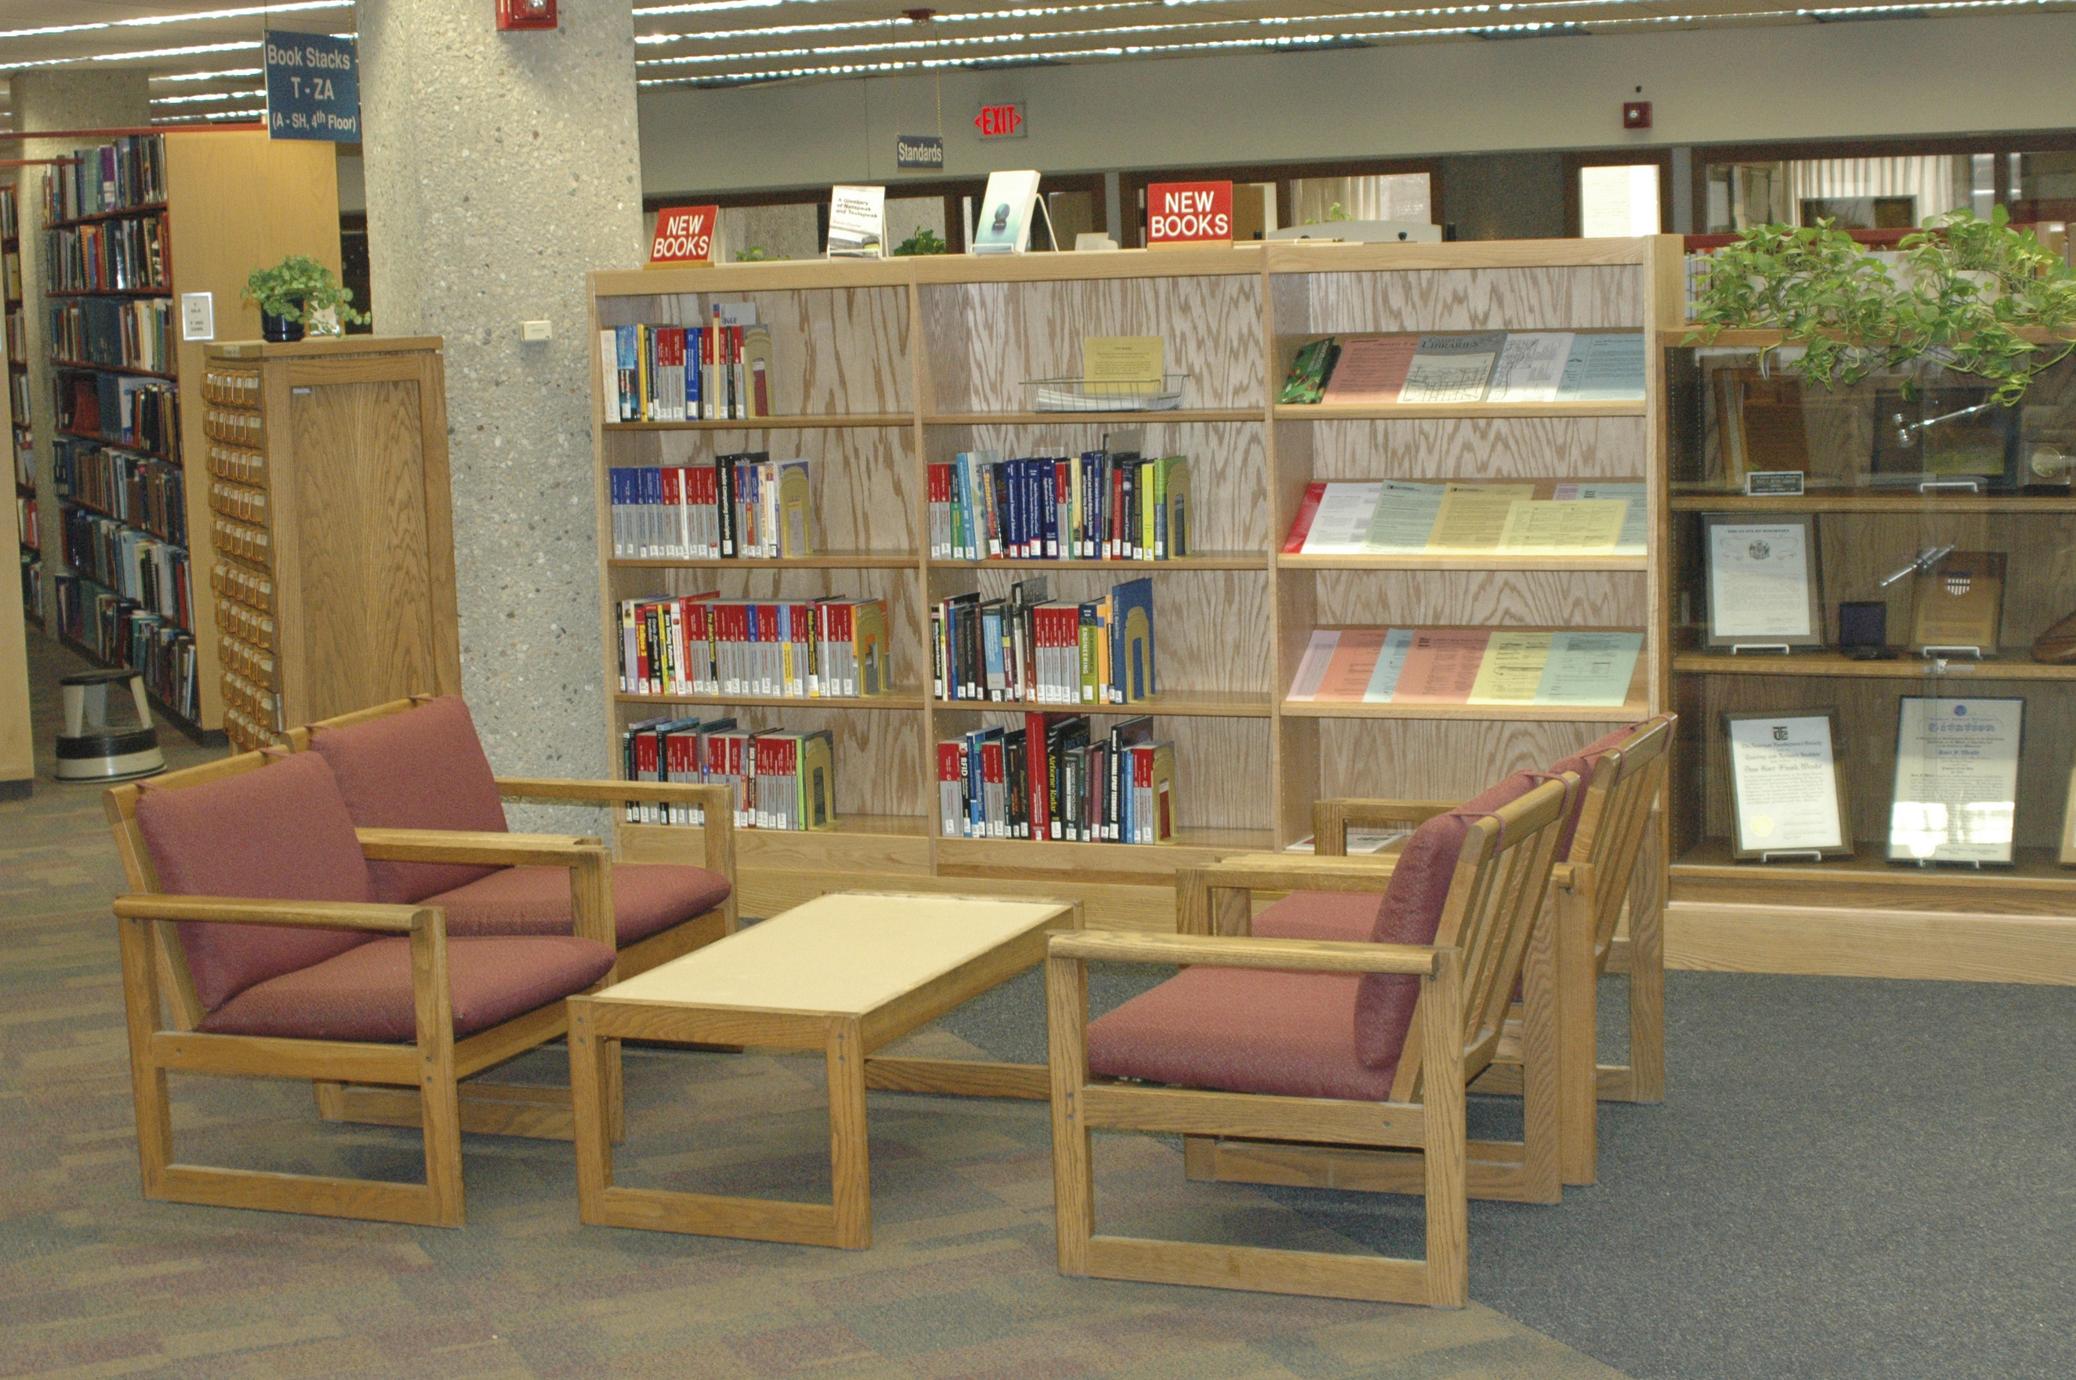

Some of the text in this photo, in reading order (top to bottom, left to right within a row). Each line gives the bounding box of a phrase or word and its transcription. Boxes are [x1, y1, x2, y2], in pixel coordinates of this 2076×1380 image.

[267, 44, 351, 71] Book Stacks
[290, 77, 301, 99] T
[313, 78, 335, 100] ZA
[272, 112, 284, 131] (A
[291, 113, 310, 131] SH,
[328, 114, 356, 134] Floor)
[981, 104, 1016, 136] EXIT
[898, 141, 942, 163] Standards
[1165, 190, 1215, 214] NEW
[666, 214, 705, 236] NEW
[1151, 213, 1229, 238] BOOKS
[653, 235, 709, 258] BOOKS
